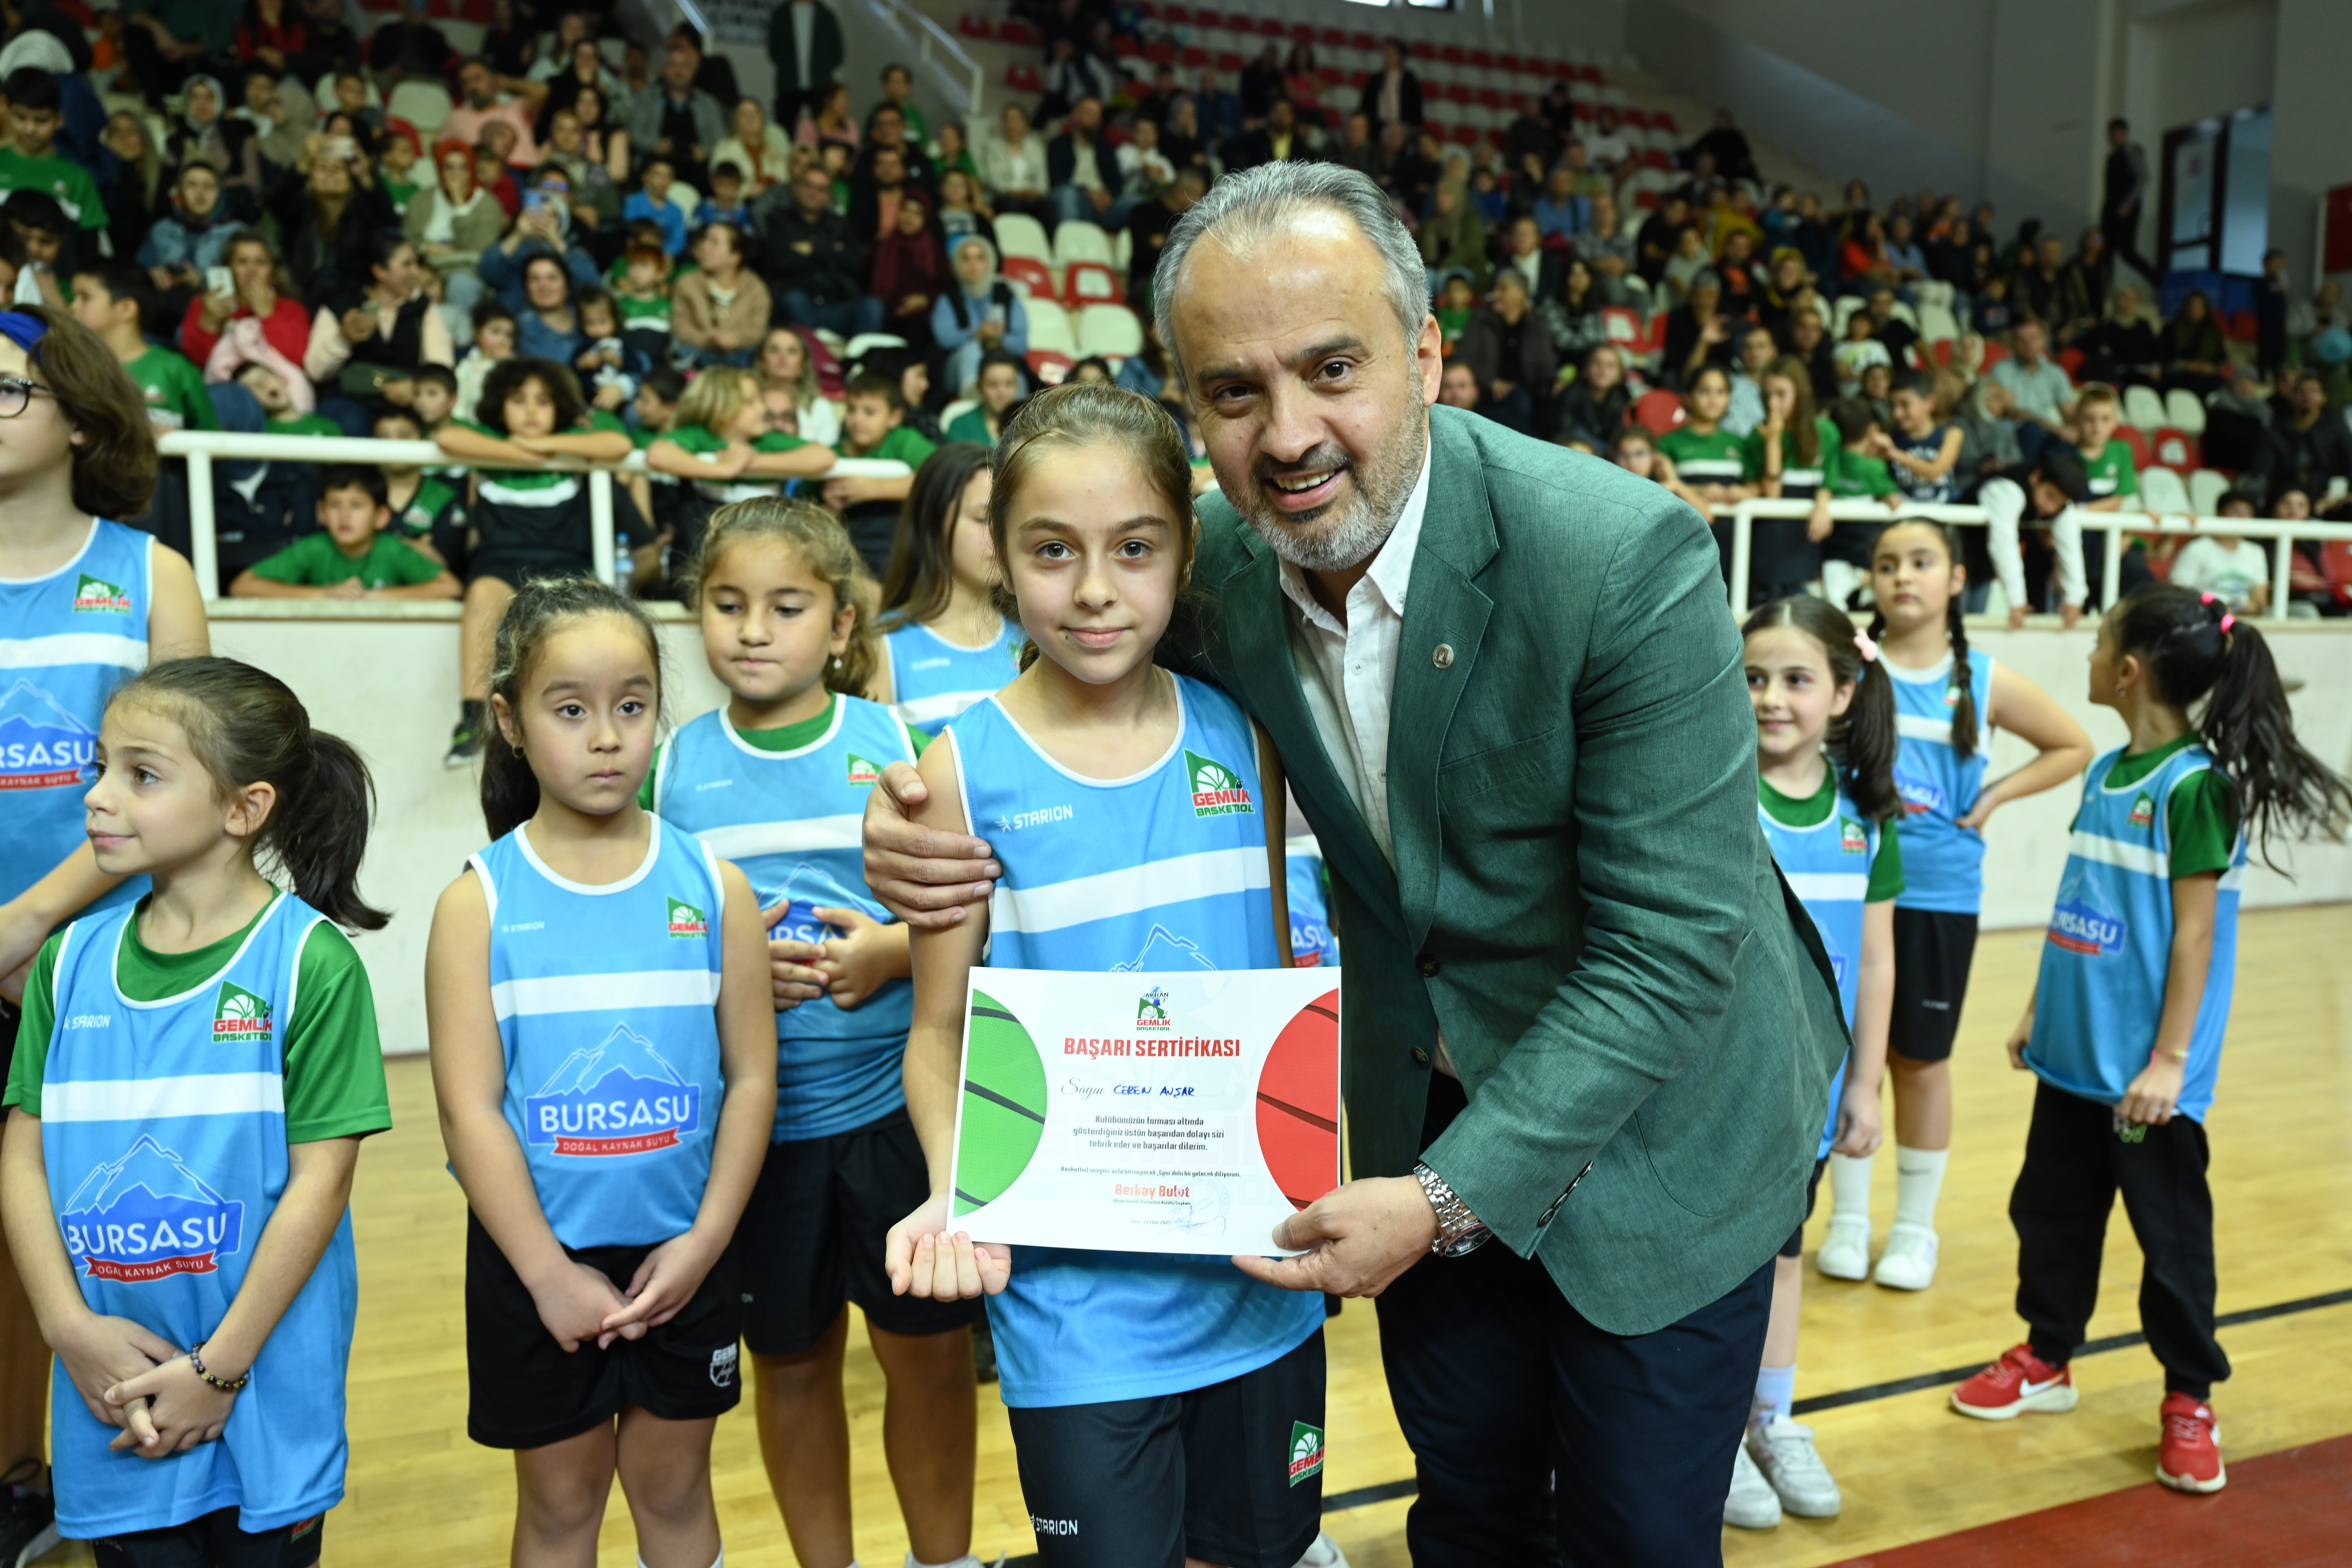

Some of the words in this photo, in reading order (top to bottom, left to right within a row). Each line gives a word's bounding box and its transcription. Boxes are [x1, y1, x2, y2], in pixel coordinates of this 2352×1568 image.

[1014, 804, 1073, 830] STARION
[1064, 1038, 1130, 1060] BAŞARI
[1136, 1036, 1240, 1057] SERTİFİKASI
[540, 1094, 690, 1133] BURSASU
[1096, 1116, 1145, 1124] Kulübümüzün
[1073, 1127, 1123, 1138] gösterdiğiniz
[1148, 1129, 1185, 1139] başarıdan
[1187, 1129, 1210, 1140] dolayı
[1212, 1130, 1224, 1138] sizi
[602, 1138, 643, 1152] KAYNAK
[646, 1135, 670, 1148] SUYU
[1143, 1141, 1177, 1151] başarılar
[1179, 1142, 1208, 1150] dilerim.
[1115, 1183, 1156, 1199] Berkay
[1159, 1185, 1190, 1198] Bulut
[67, 1212, 227, 1255] BURSASU
[125, 1264, 172, 1278] KAYNAK
[176, 1260, 203, 1269] SUYU
[1036, 1517, 1077, 1536] STARION
